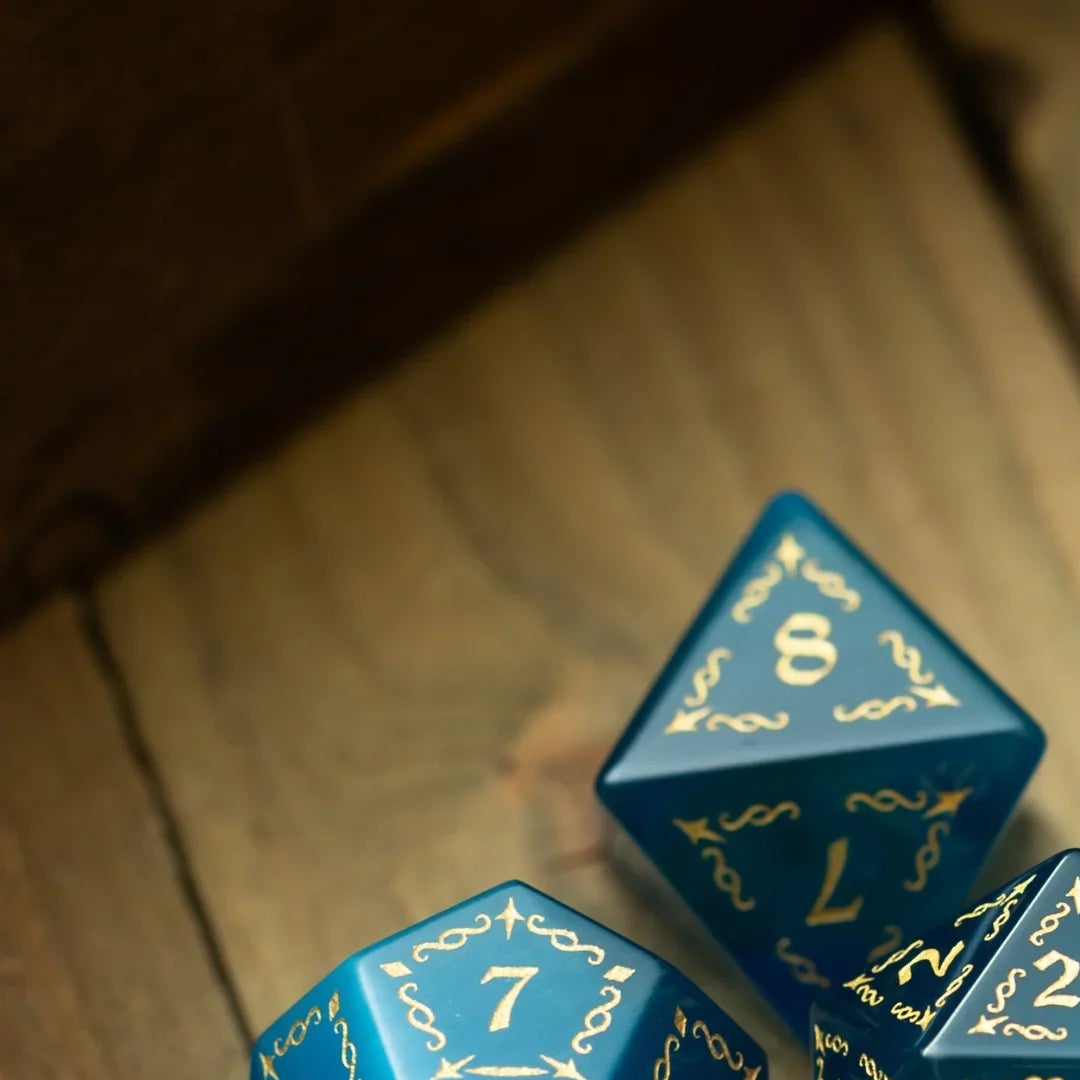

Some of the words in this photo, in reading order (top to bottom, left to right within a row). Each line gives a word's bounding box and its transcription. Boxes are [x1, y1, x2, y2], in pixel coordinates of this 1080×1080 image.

[773, 612, 838, 686] 8
[805, 838, 863, 927] 7
[481, 965, 539, 1033] 7
[896, 940, 965, 987] 2
